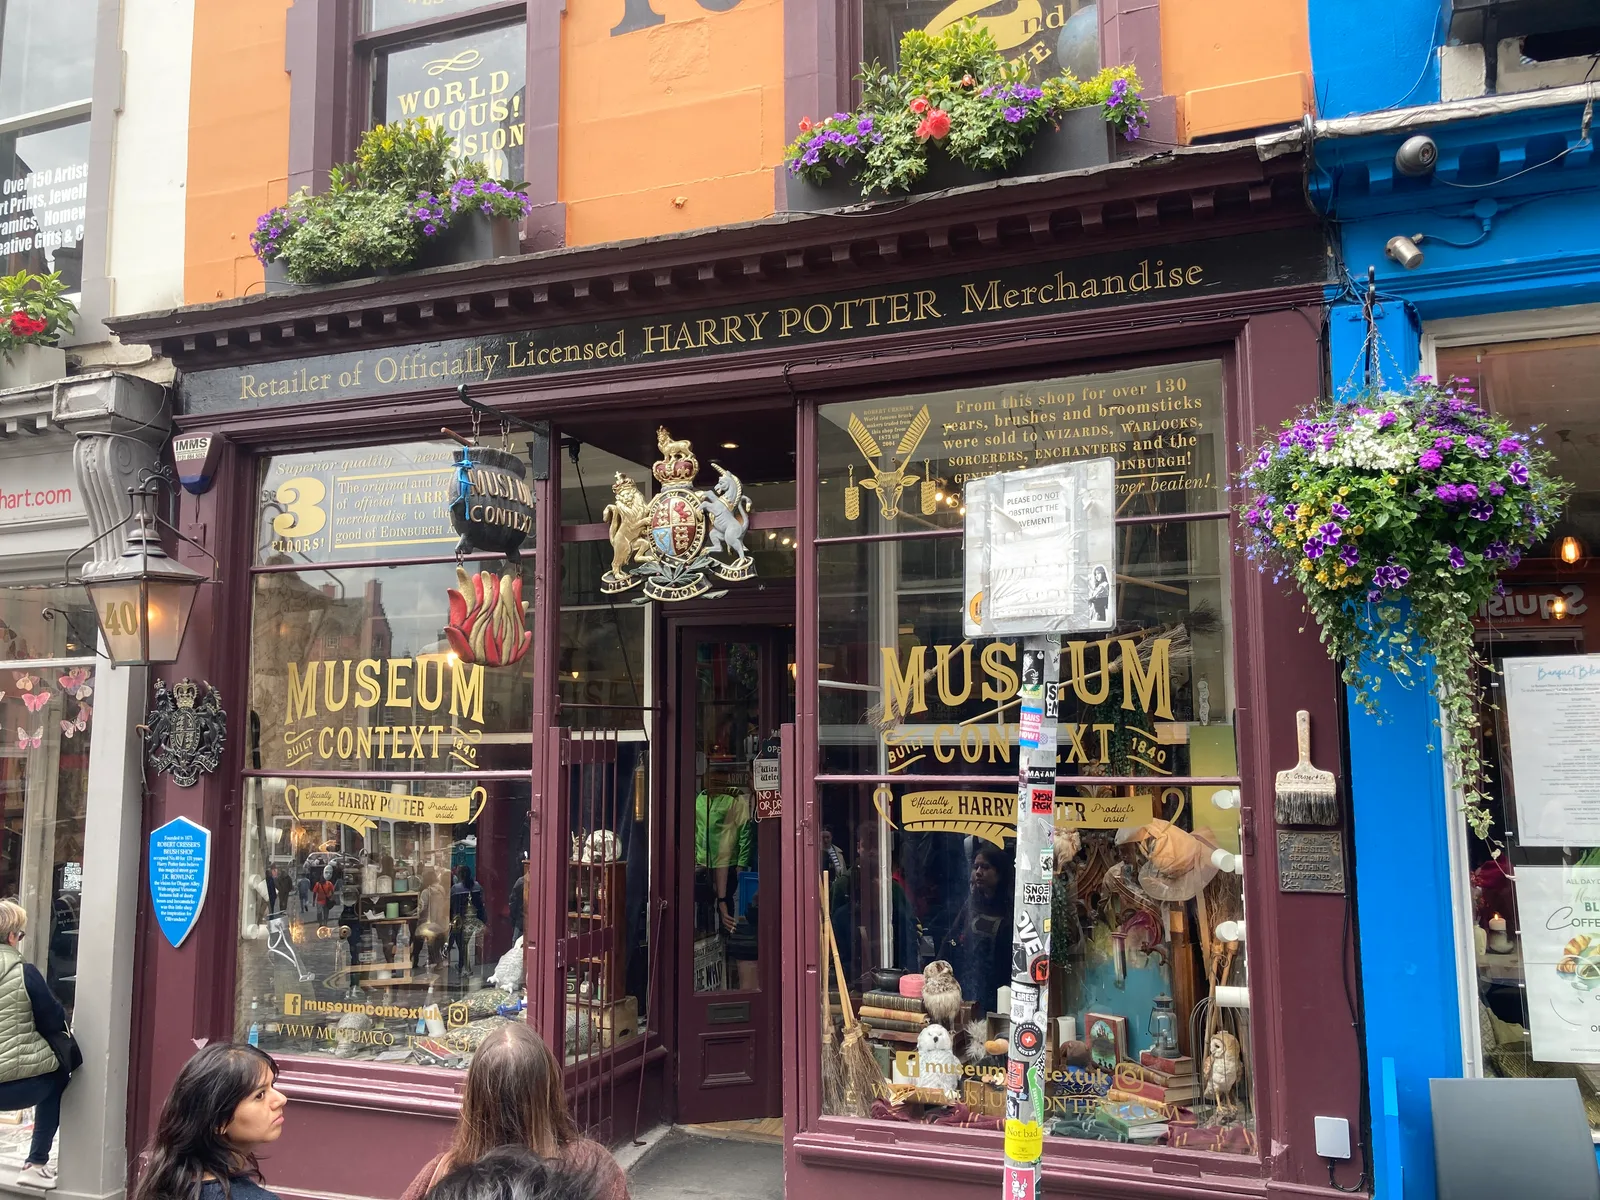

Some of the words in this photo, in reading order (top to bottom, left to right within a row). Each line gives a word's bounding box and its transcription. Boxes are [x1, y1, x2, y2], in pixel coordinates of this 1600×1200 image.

[398, 70, 509, 115] WORLD
[398, 95, 520, 137] MOUS!
[3, 177, 28, 195] Over
[32, 169, 52, 189] 150
[54, 162, 89, 184] Artist
[10, 193, 47, 214] Prints,
[49, 182, 87, 205] Jewell
[0, 215, 39, 235] ramics,
[0, 237, 33, 257] eative
[35, 230, 63, 249] Gifts
[64, 229, 74, 243] &
[240, 367, 331, 400] Retailer
[338, 360, 363, 388] of
[374, 344, 499, 385] Officially
[506, 329, 626, 369] Licensed
[644, 311, 769, 354] HARRY
[779, 291, 941, 337] POTTER
[961, 260, 1204, 315] Merchandise
[955, 400, 996, 415] From
[1002, 394, 1033, 410] this
[1038, 389, 1075, 408] shop
[1082, 387, 1106, 402] for
[1112, 385, 1147, 398] over
[1155, 377, 1187, 394] 130
[942, 418, 989, 436] years,
[994, 408, 1057, 428] brushes
[1063, 404, 1092, 421] and
[1098, 396, 1203, 418] broomsticks
[942, 435, 979, 450] were
[985, 430, 1016, 446] sold
[1023, 429, 1038, 443] to
[1045, 425, 1115, 441] WIZARDS,
[1120, 416, 1204, 433] WARLOCKS,
[176, 437, 208, 451] IMMS
[948, 451, 1028, 467] SORCERERS,
[1035, 442, 1127, 459] ENCHANTERS
[1133, 436, 1163, 451] and
[1170, 433, 1198, 448] the
[276, 460, 338, 476] Superior
[341, 454, 393, 472] quality
[1114, 451, 1192, 471] DINBURGH!
[338, 481, 360, 494] The
[362, 477, 409, 495] original
[411, 475, 432, 489] and
[1114, 481, 1146, 495] ever
[1151, 472, 1212, 492] beaten!
[273, 477, 327, 538] 3
[336, 499, 348, 510] of
[354, 494, 396, 511] official
[403, 490, 450, 505] HARRY
[1007, 494, 1031, 506] PLEASE
[1032, 494, 1043, 502] DO
[1045, 491, 1060, 500] NOT
[1046, 503, 1059, 512] THE
[336, 510, 407, 526] merchandise
[414, 510, 425, 520] to
[433, 506, 450, 518] the
[1017, 516, 1054, 528] AVEMENT!
[335, 527, 361, 544] good
[366, 528, 377, 539] of
[381, 525, 442, 538] EDINBURGH
[271, 538, 325, 553] FLOORS!
[104, 601, 138, 636] 40
[284, 656, 485, 726] MUSEUM
[880, 638, 1175, 723] MUSUM
[286, 735, 313, 760] BUILT
[318, 725, 444, 760] CONTEXT
[452, 735, 476, 759] 1840
[767, 745, 781, 754] OPE
[888, 736, 924, 764] BUILT
[932, 722, 1115, 764] CONXT
[1131, 736, 1167, 764] 1840
[305, 791, 333, 800] Officially
[310, 799, 335, 808] licensed
[338, 791, 377, 811] HARRY
[380, 796, 425, 818] POTTER
[758, 790, 772, 800] NO
[759, 801, 772, 810] OR
[910, 796, 950, 808] Officially
[428, 802, 459, 811] Products
[435, 811, 455, 819] inside
[920, 805, 954, 817] licensed
[958, 796, 1015, 818] HARRY
[1090, 803, 1135, 814] Products
[1546, 906, 1600, 931] COFFE
[925, 1060, 1109, 1086] museumtextuk
[1007, 1125, 1022, 1138] Not
